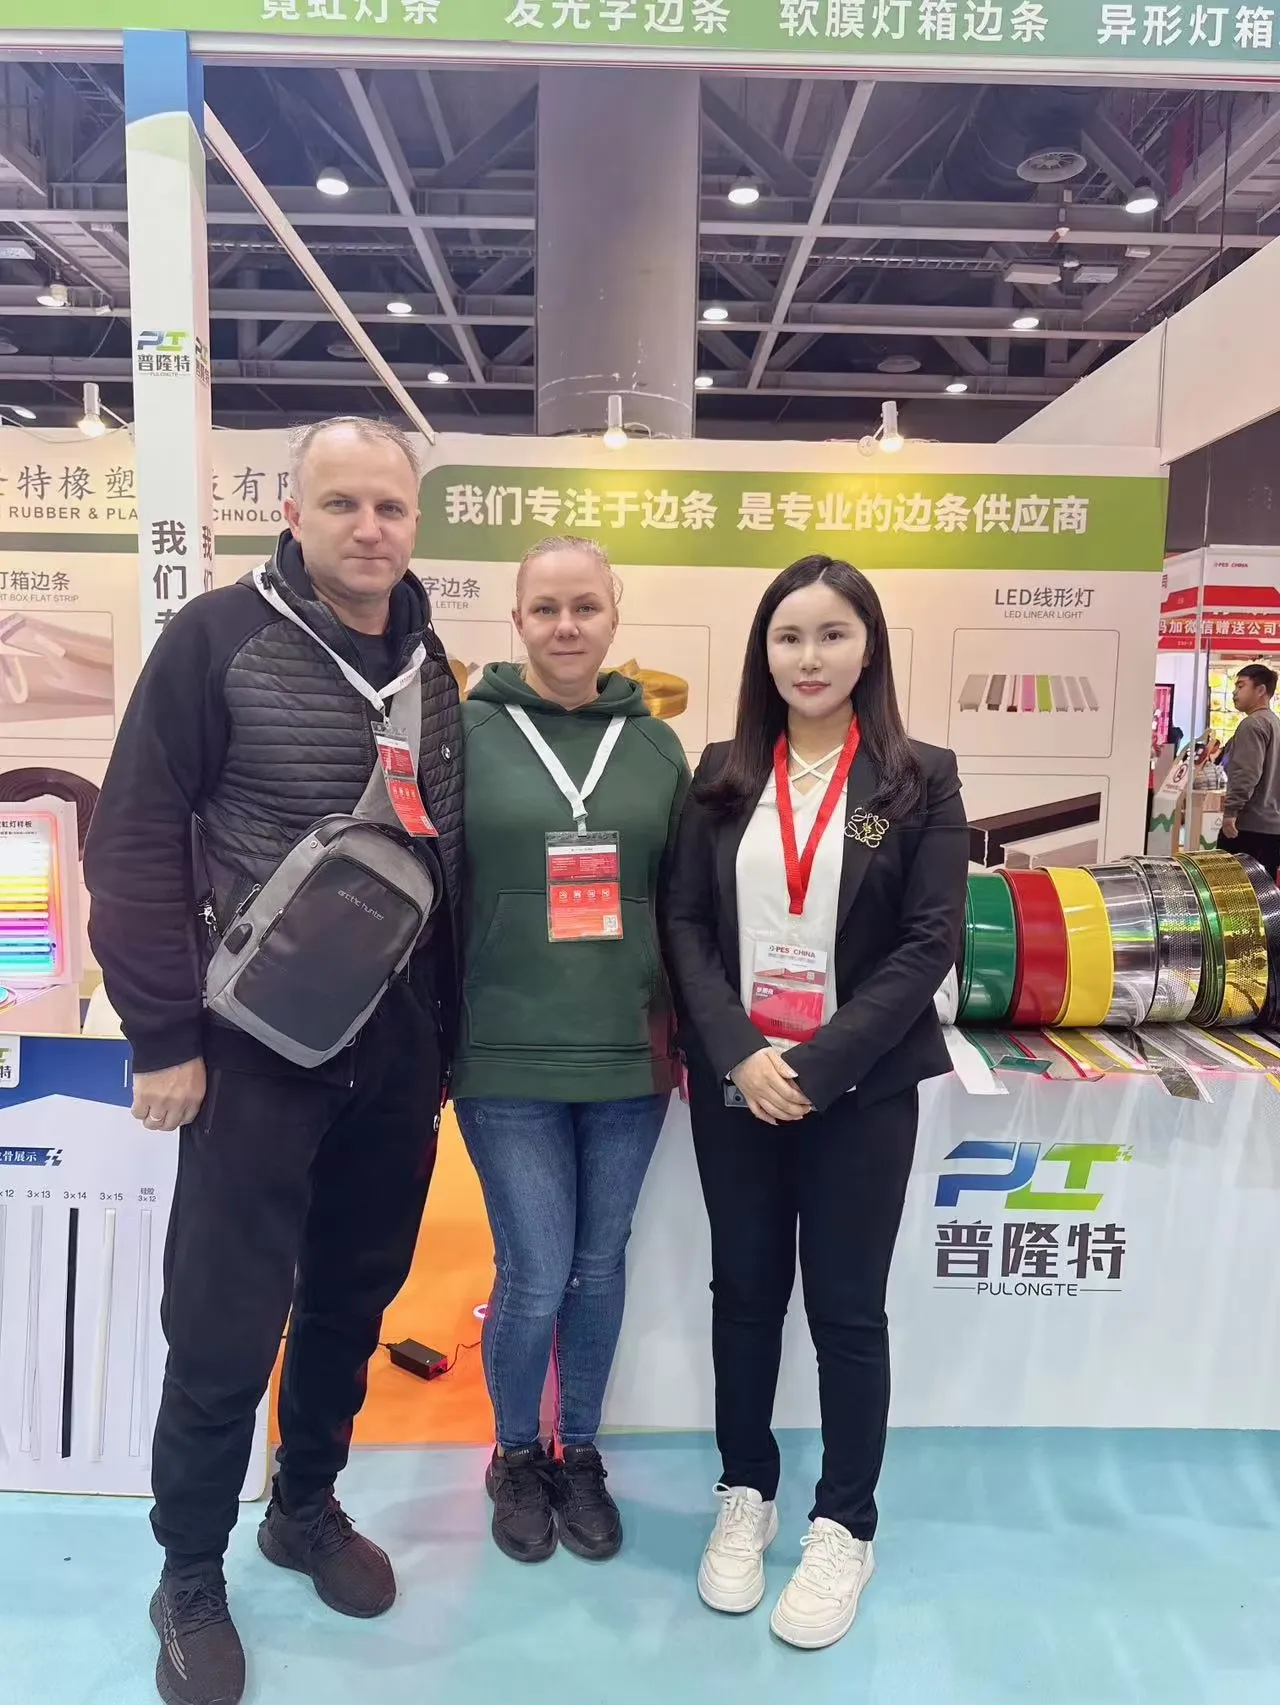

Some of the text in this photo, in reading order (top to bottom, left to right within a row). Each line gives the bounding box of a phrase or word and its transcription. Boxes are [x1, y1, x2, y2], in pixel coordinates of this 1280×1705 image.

[504, 0, 731, 34] 发光字边条
[779, 0, 1049, 43] 软膜灯箱边条
[1096, 4, 1275, 48] 异形灯箱
[137, 354, 191, 372] 普隆特
[0, 464, 137, 501] 特橡塑
[9, 505, 81, 519] RUBBER
[88, 507, 98, 519] &
[445, 484, 1090, 535] 我们专注于边条 是专业的边条供应商
[421, 576, 481, 598] 字边条
[435, 600, 470, 609] LETTER
[994, 587, 1095, 608] LED线形灯
[1023, 611, 1055, 619] LINEAR
[793, 949, 816, 958] CHINA
[935, 1219, 1126, 1279] 普隆特
[976, 1282, 1078, 1296] PULONGTE
